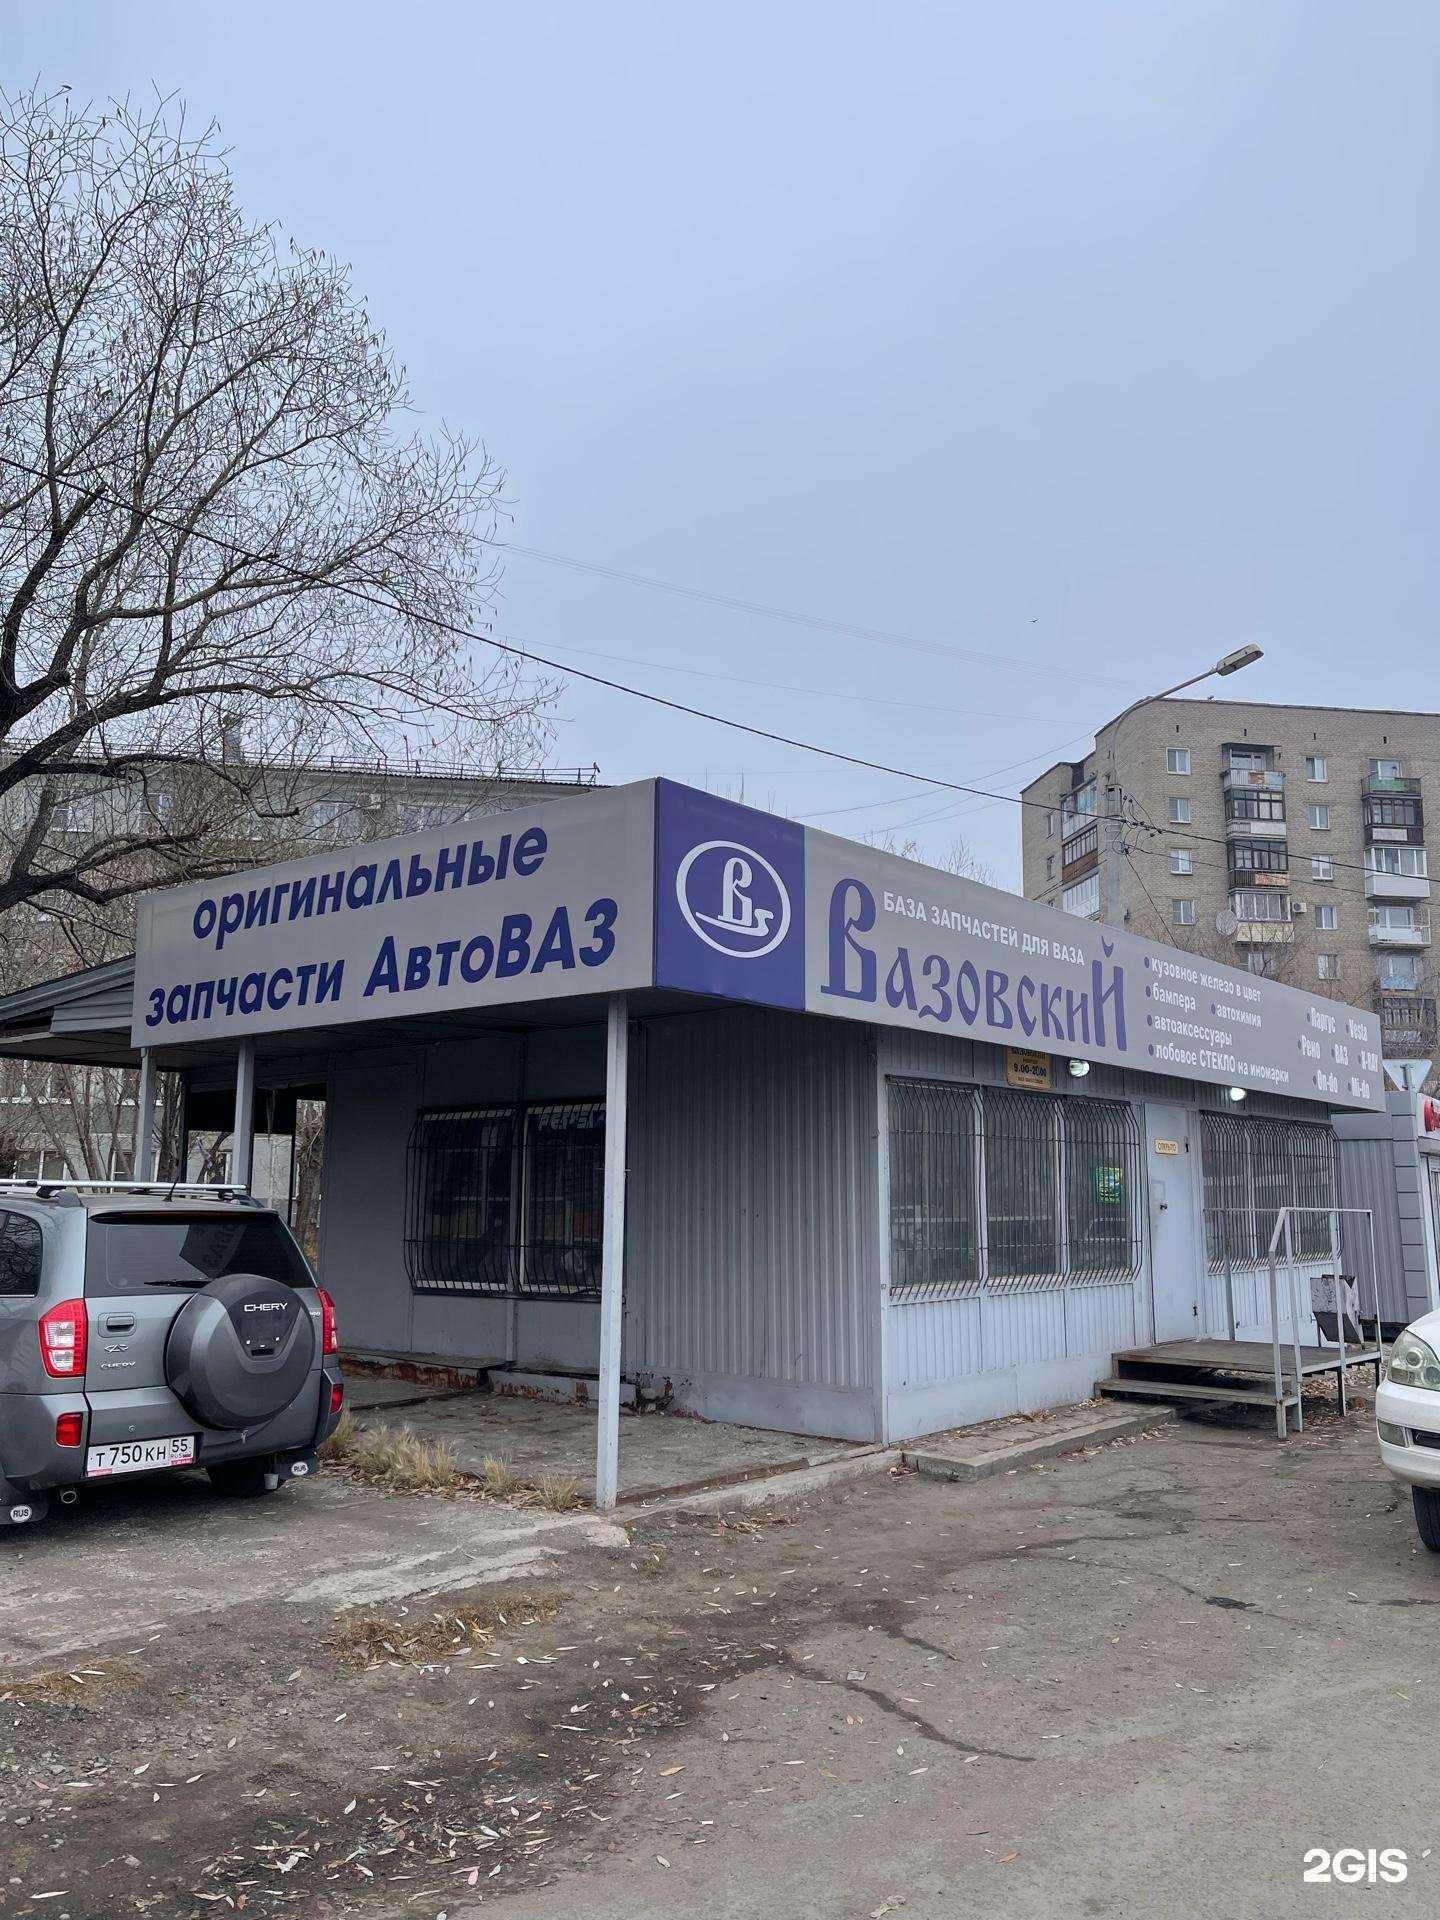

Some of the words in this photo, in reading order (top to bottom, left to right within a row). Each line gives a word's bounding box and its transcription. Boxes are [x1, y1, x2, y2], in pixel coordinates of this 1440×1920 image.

[193, 827, 548, 950] оригинальные
[883, 891, 927, 922] БАЗА
[931, 905, 1019, 948] ЗАПЧАСТЕЙ
[1022, 933, 1049, 956] ДЛЯ
[1053, 942, 1085, 966] ВАЗА
[146, 959, 346, 1027] запчасти
[363, 898, 619, 997] АвтоВАЗ
[1151, 957, 1198, 984] кузовное
[1199, 973, 1234, 995] железо
[1236, 984, 1241, 995] в
[1243, 985, 1264, 1003] цвет
[1152, 982, 1197, 1014] бампера
[1154, 1014, 1233, 1048] автоаксессуары
[1216, 1003, 1262, 1029] автохимия
[1155, 1043, 1197, 1066] лобовое
[1199, 1049, 1236, 1073] СТЕКЛО
[1238, 1061, 1249, 1076] на
[1250, 1062, 1289, 1086] иномарки
[244, 1302, 288, 1313] CHERY
[171, 1438, 188, 1453] 55
[13, 1508, 29, 1518] RUS
